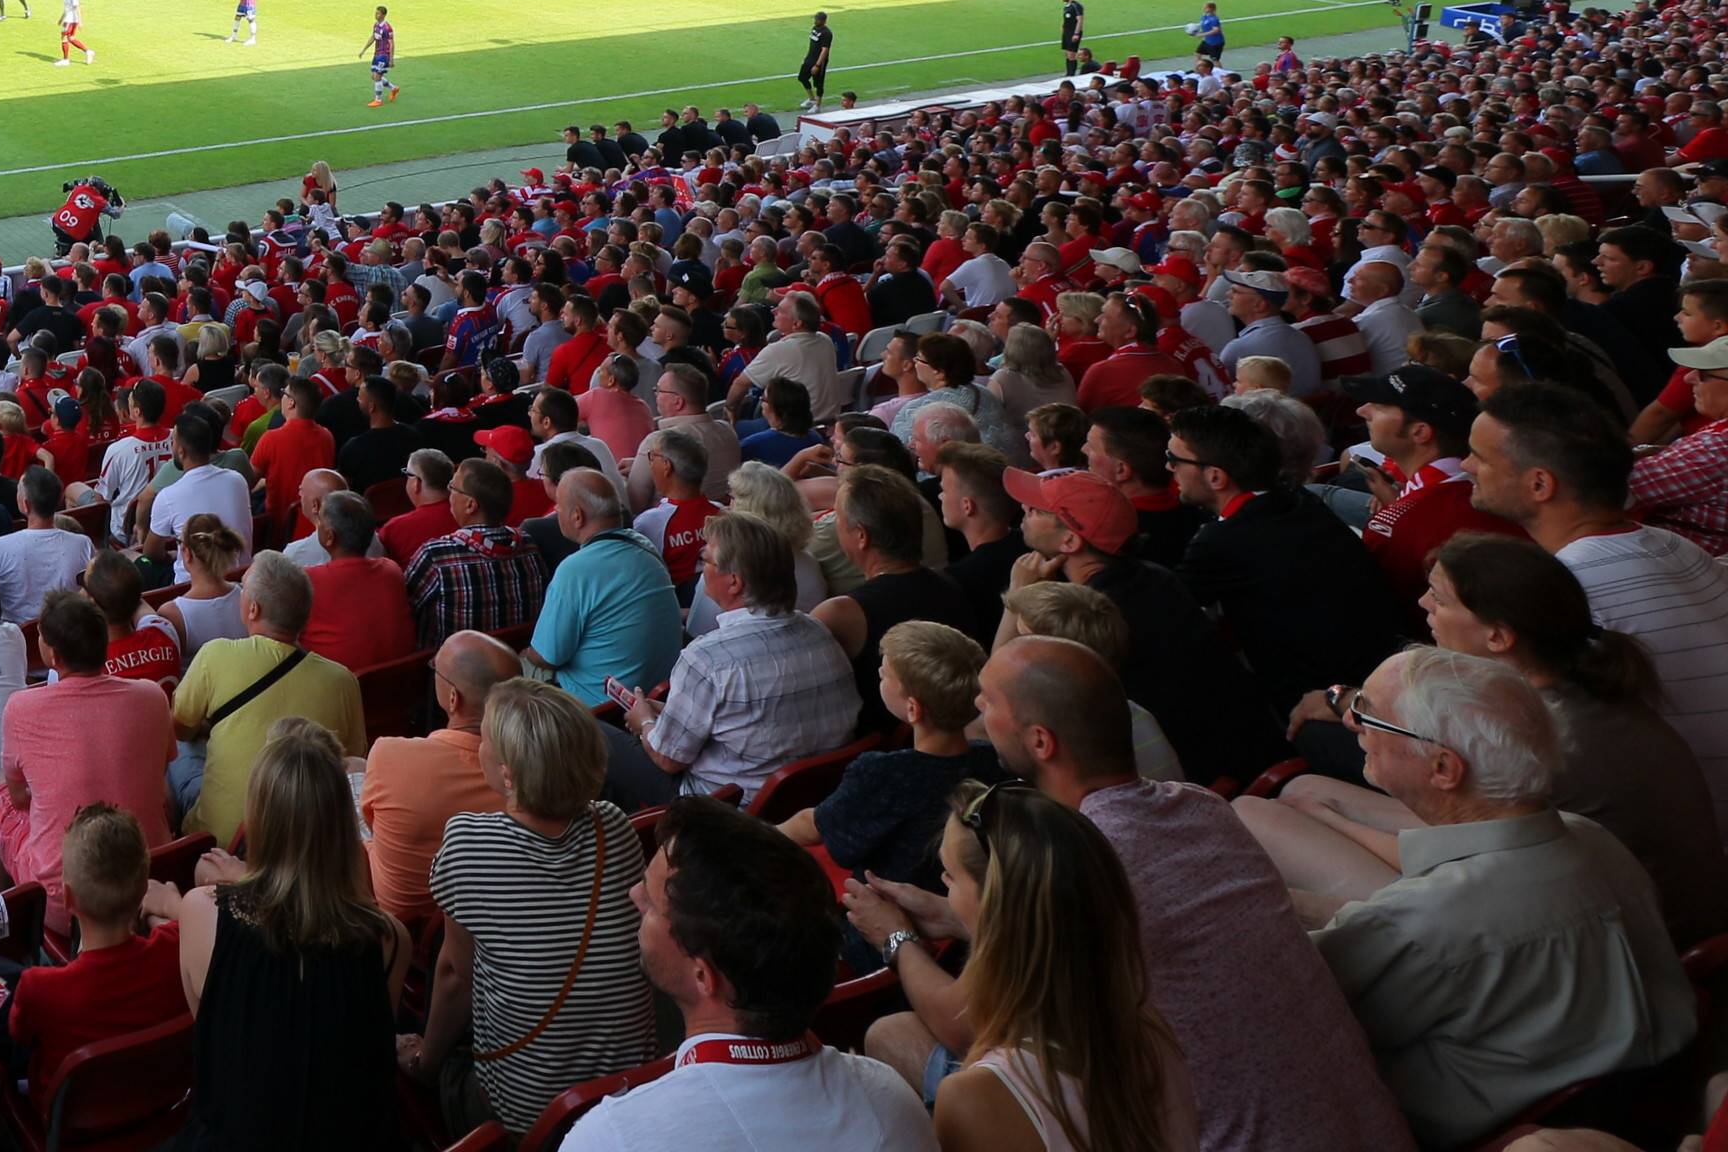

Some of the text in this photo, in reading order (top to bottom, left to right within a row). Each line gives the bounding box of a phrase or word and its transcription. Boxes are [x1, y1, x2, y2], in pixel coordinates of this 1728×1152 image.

[59, 209, 79, 228] 09
[668, 531, 693, 549] MC
[103, 645, 174, 677] ENERGIE
[729, 1043, 772, 1061] COTTBUS
